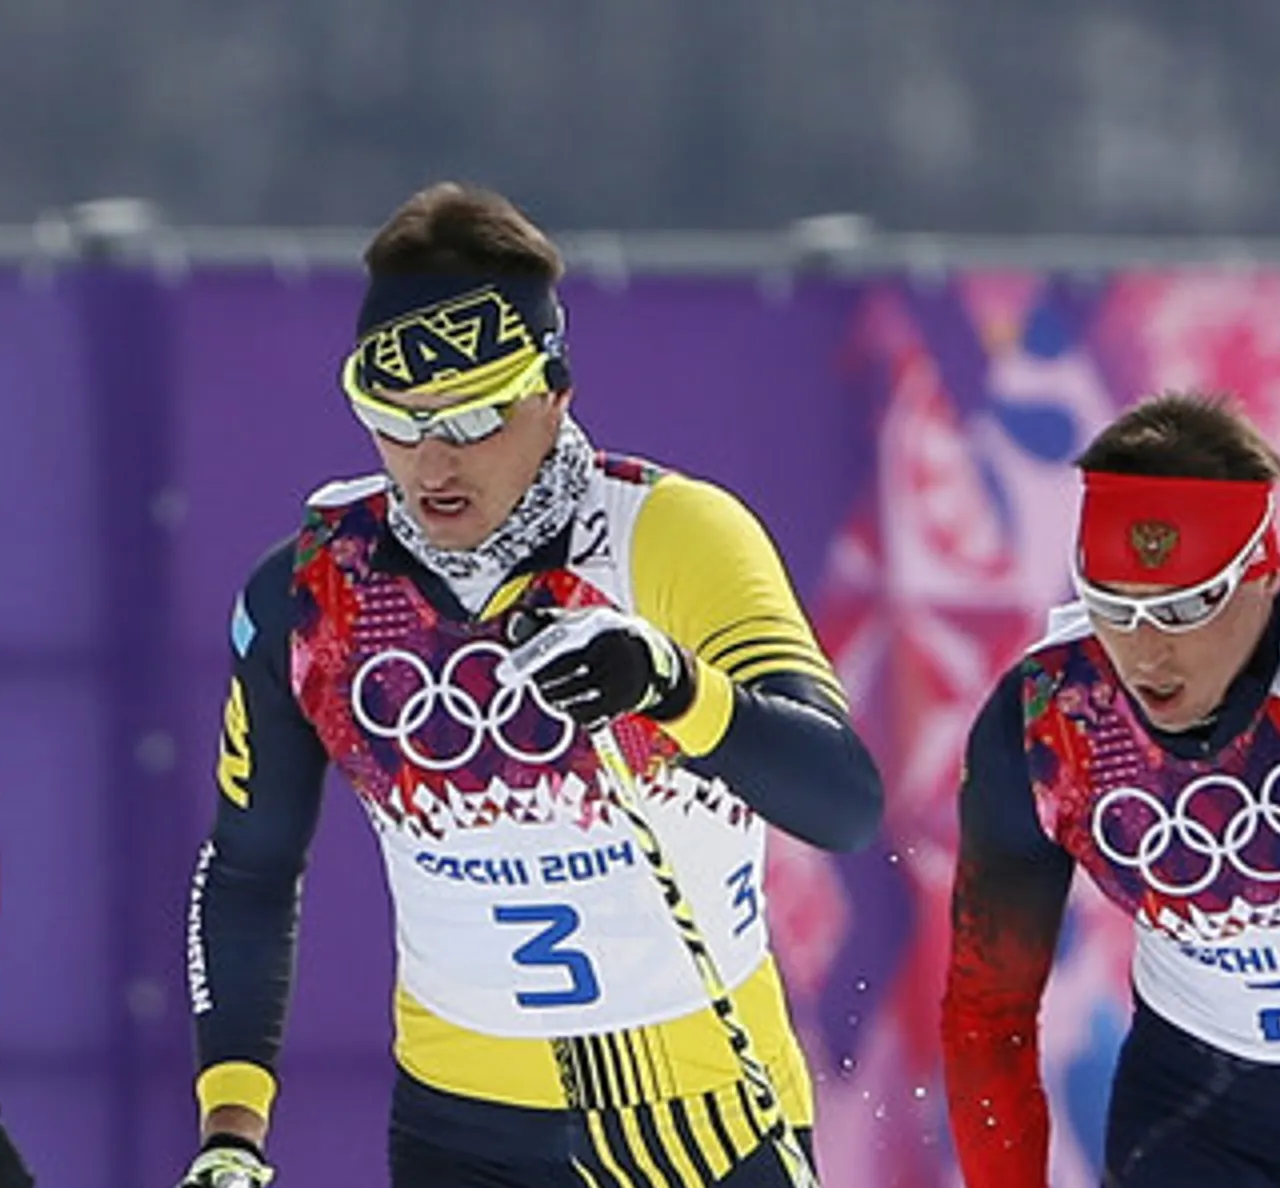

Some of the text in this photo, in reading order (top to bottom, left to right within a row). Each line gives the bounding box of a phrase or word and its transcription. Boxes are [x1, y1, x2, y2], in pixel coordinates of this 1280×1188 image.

[539, 840, 635, 883] 2014
[725, 862, 759, 936] 3
[492, 904, 601, 1009] 3
